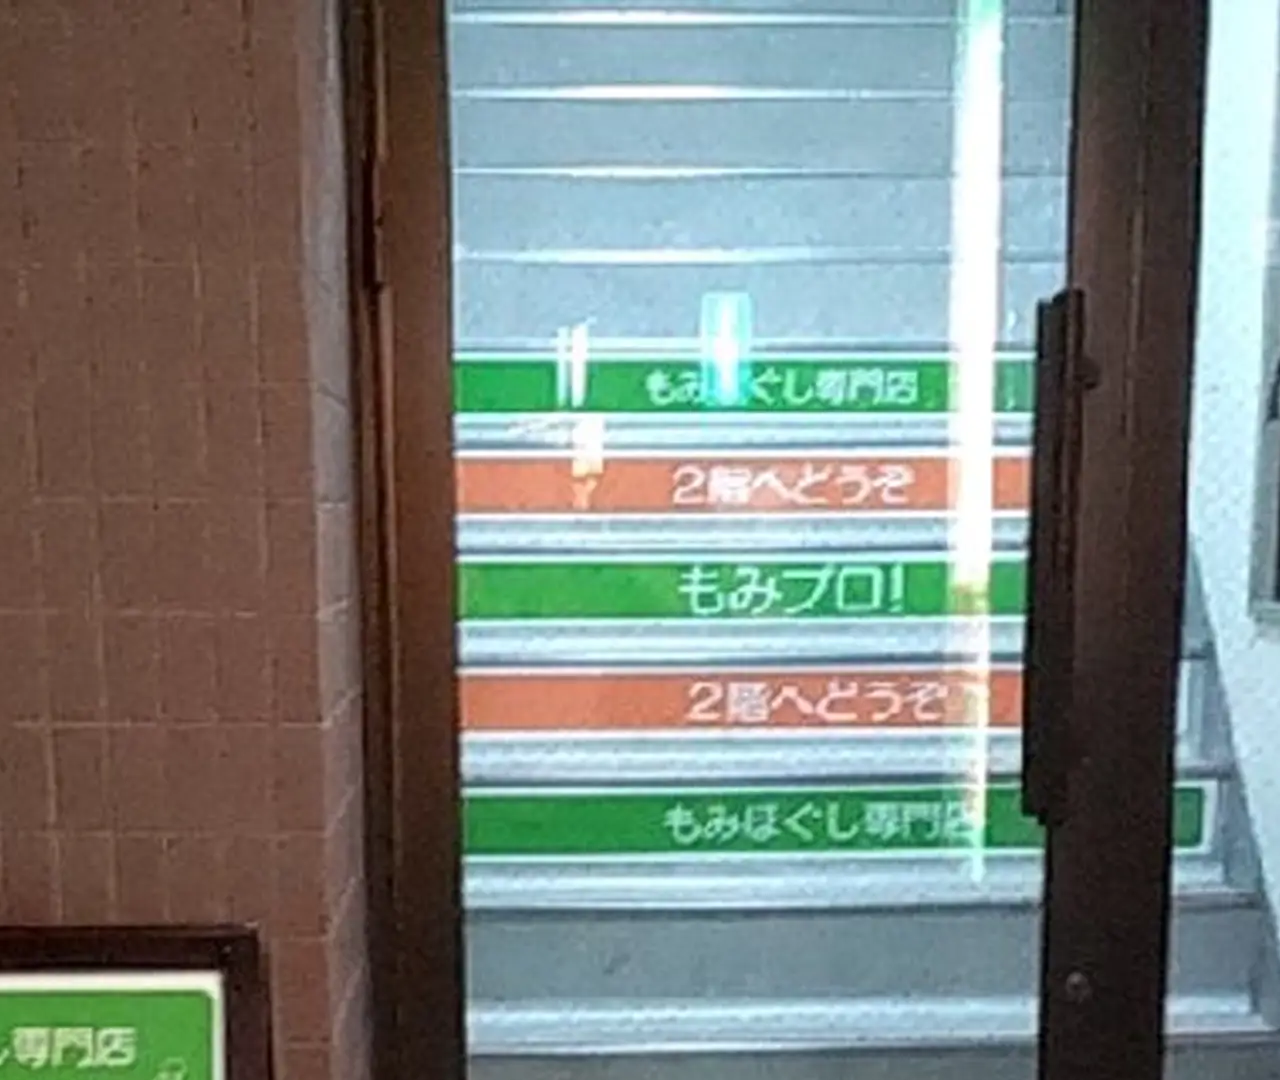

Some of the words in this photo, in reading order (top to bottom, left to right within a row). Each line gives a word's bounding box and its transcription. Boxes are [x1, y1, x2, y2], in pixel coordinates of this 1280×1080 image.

[646, 367, 918, 405] もみぐし専門店
[672, 461, 915, 504] 2階へどうぞ
[678, 563, 904, 614] もみプロ!
[686, 677, 949, 722] 2階へどうぞ
